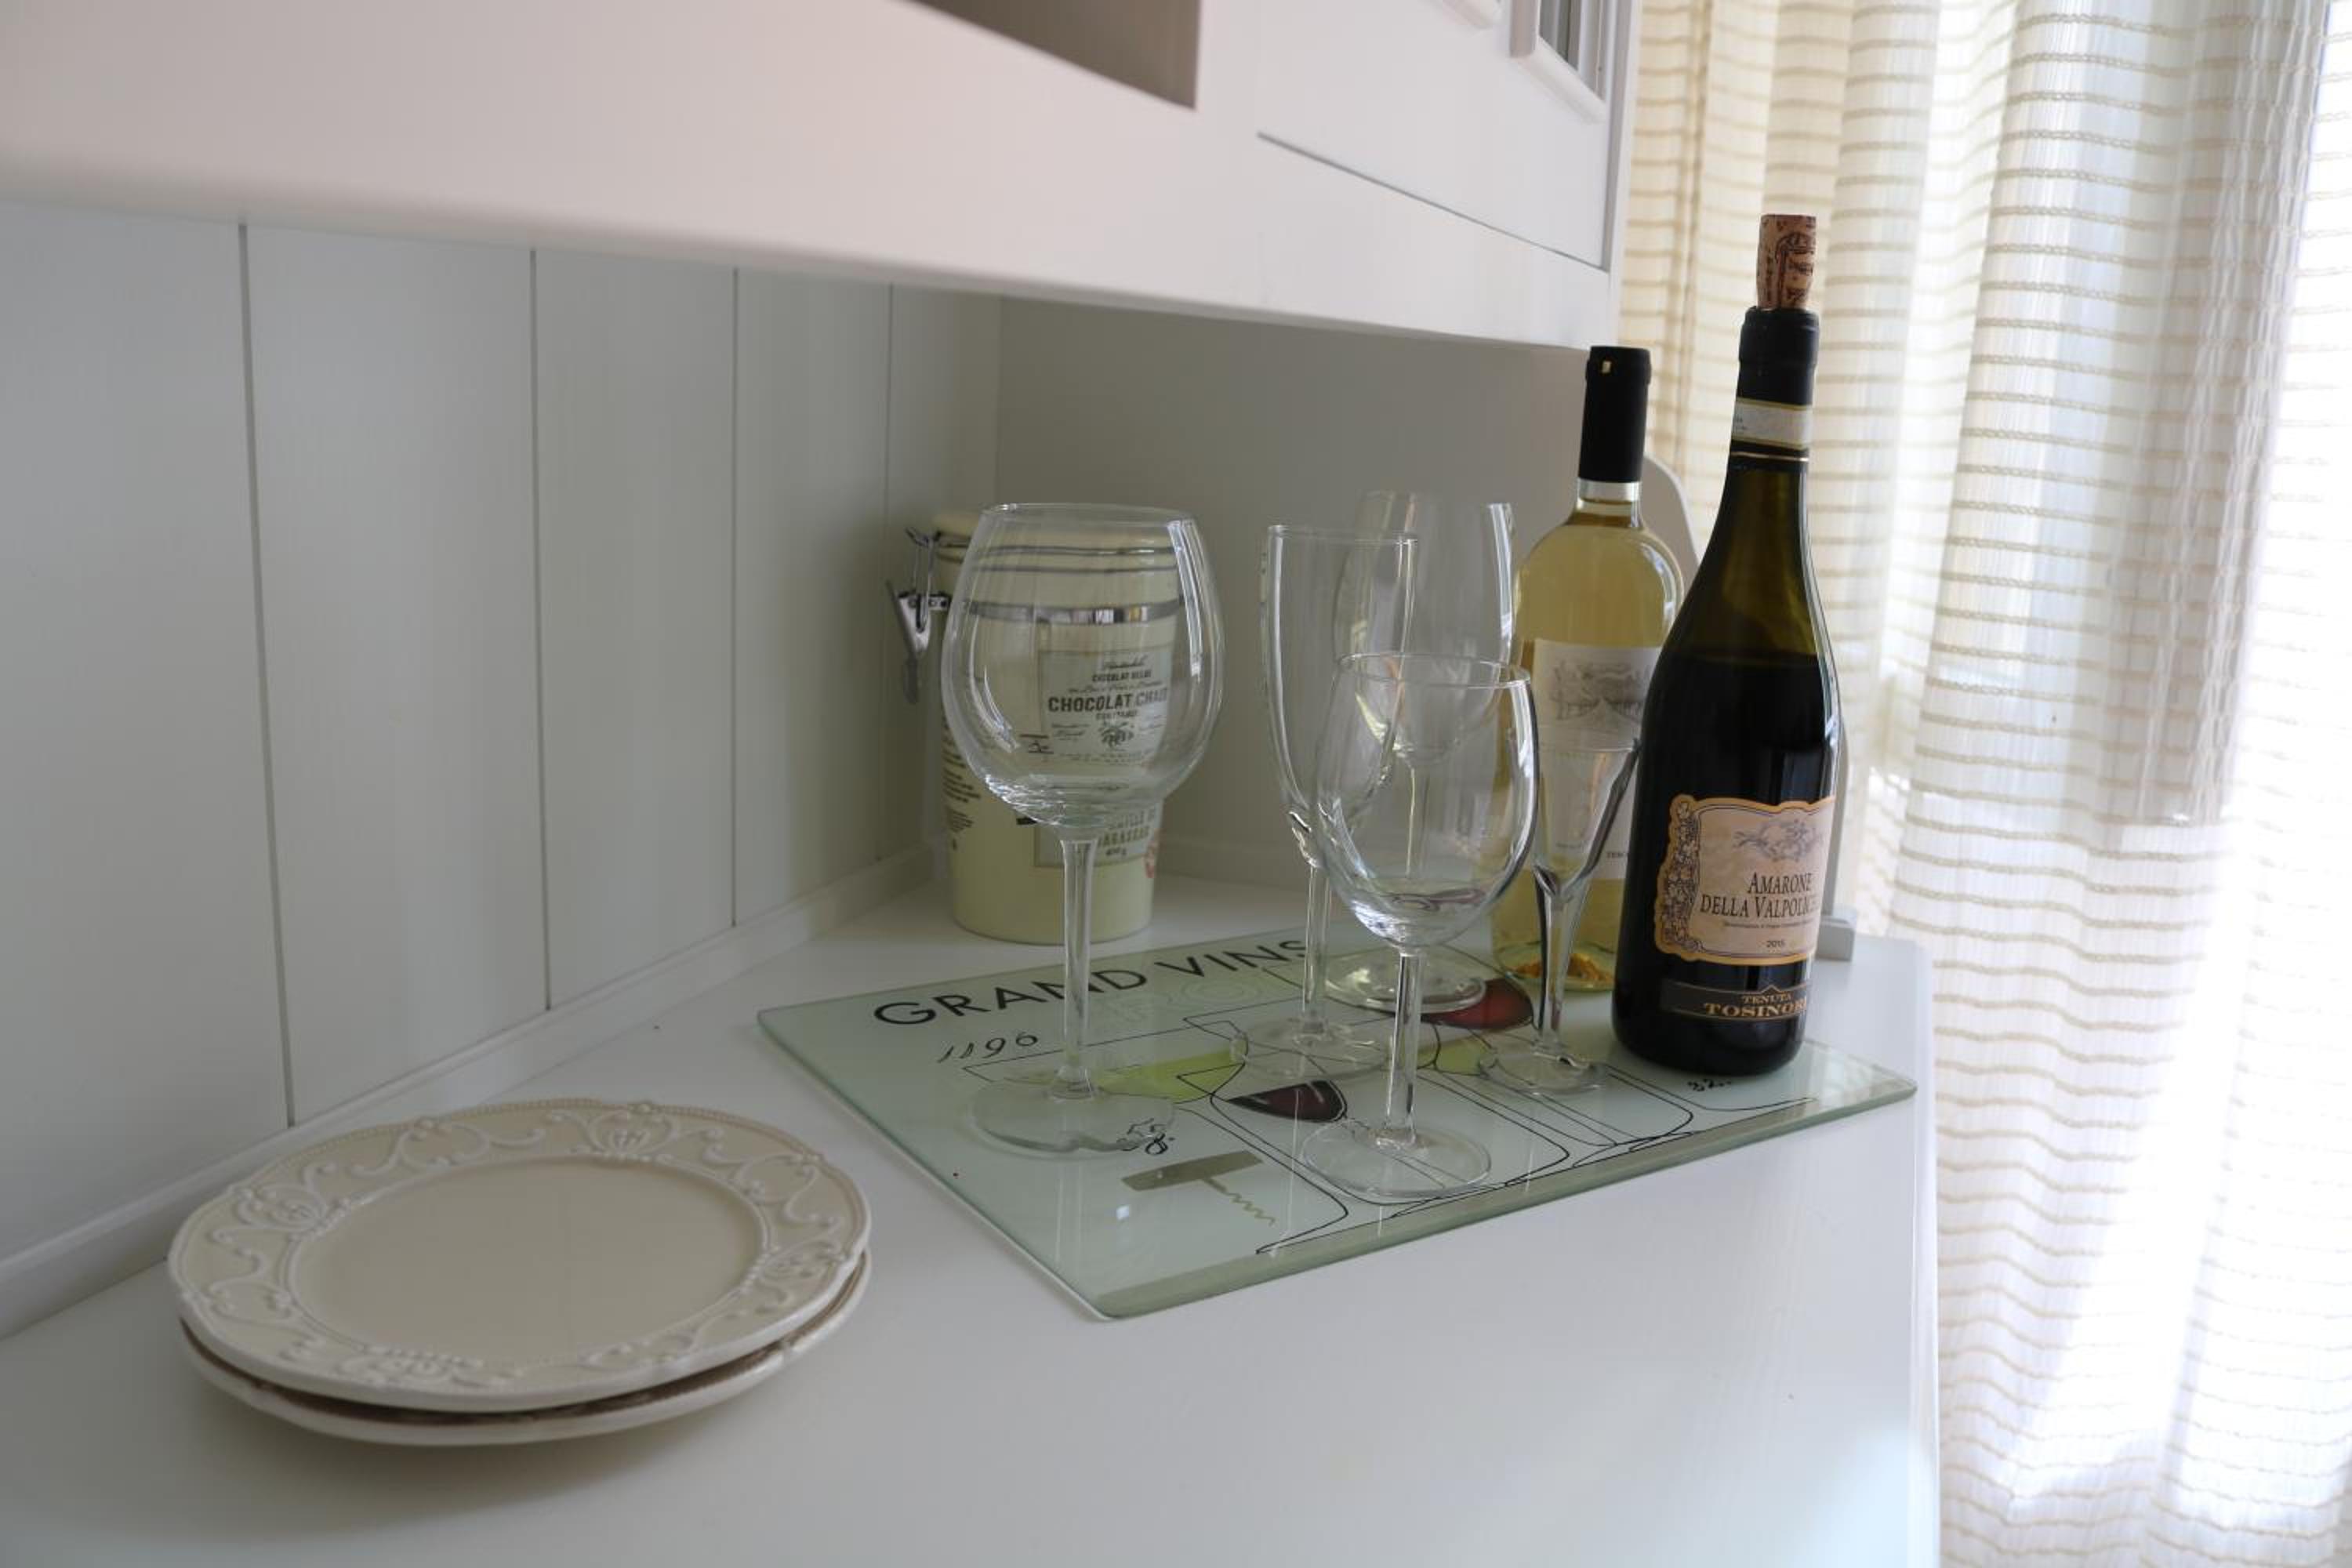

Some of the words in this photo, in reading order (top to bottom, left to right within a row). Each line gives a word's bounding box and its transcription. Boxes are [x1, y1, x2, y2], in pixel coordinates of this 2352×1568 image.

[1047, 693, 1134, 713] CHOCOLAT
[1748, 871, 1813, 895] AMARONE
[1700, 893, 1749, 918] DELLA
[1742, 989, 1792, 1004] TENUTA
